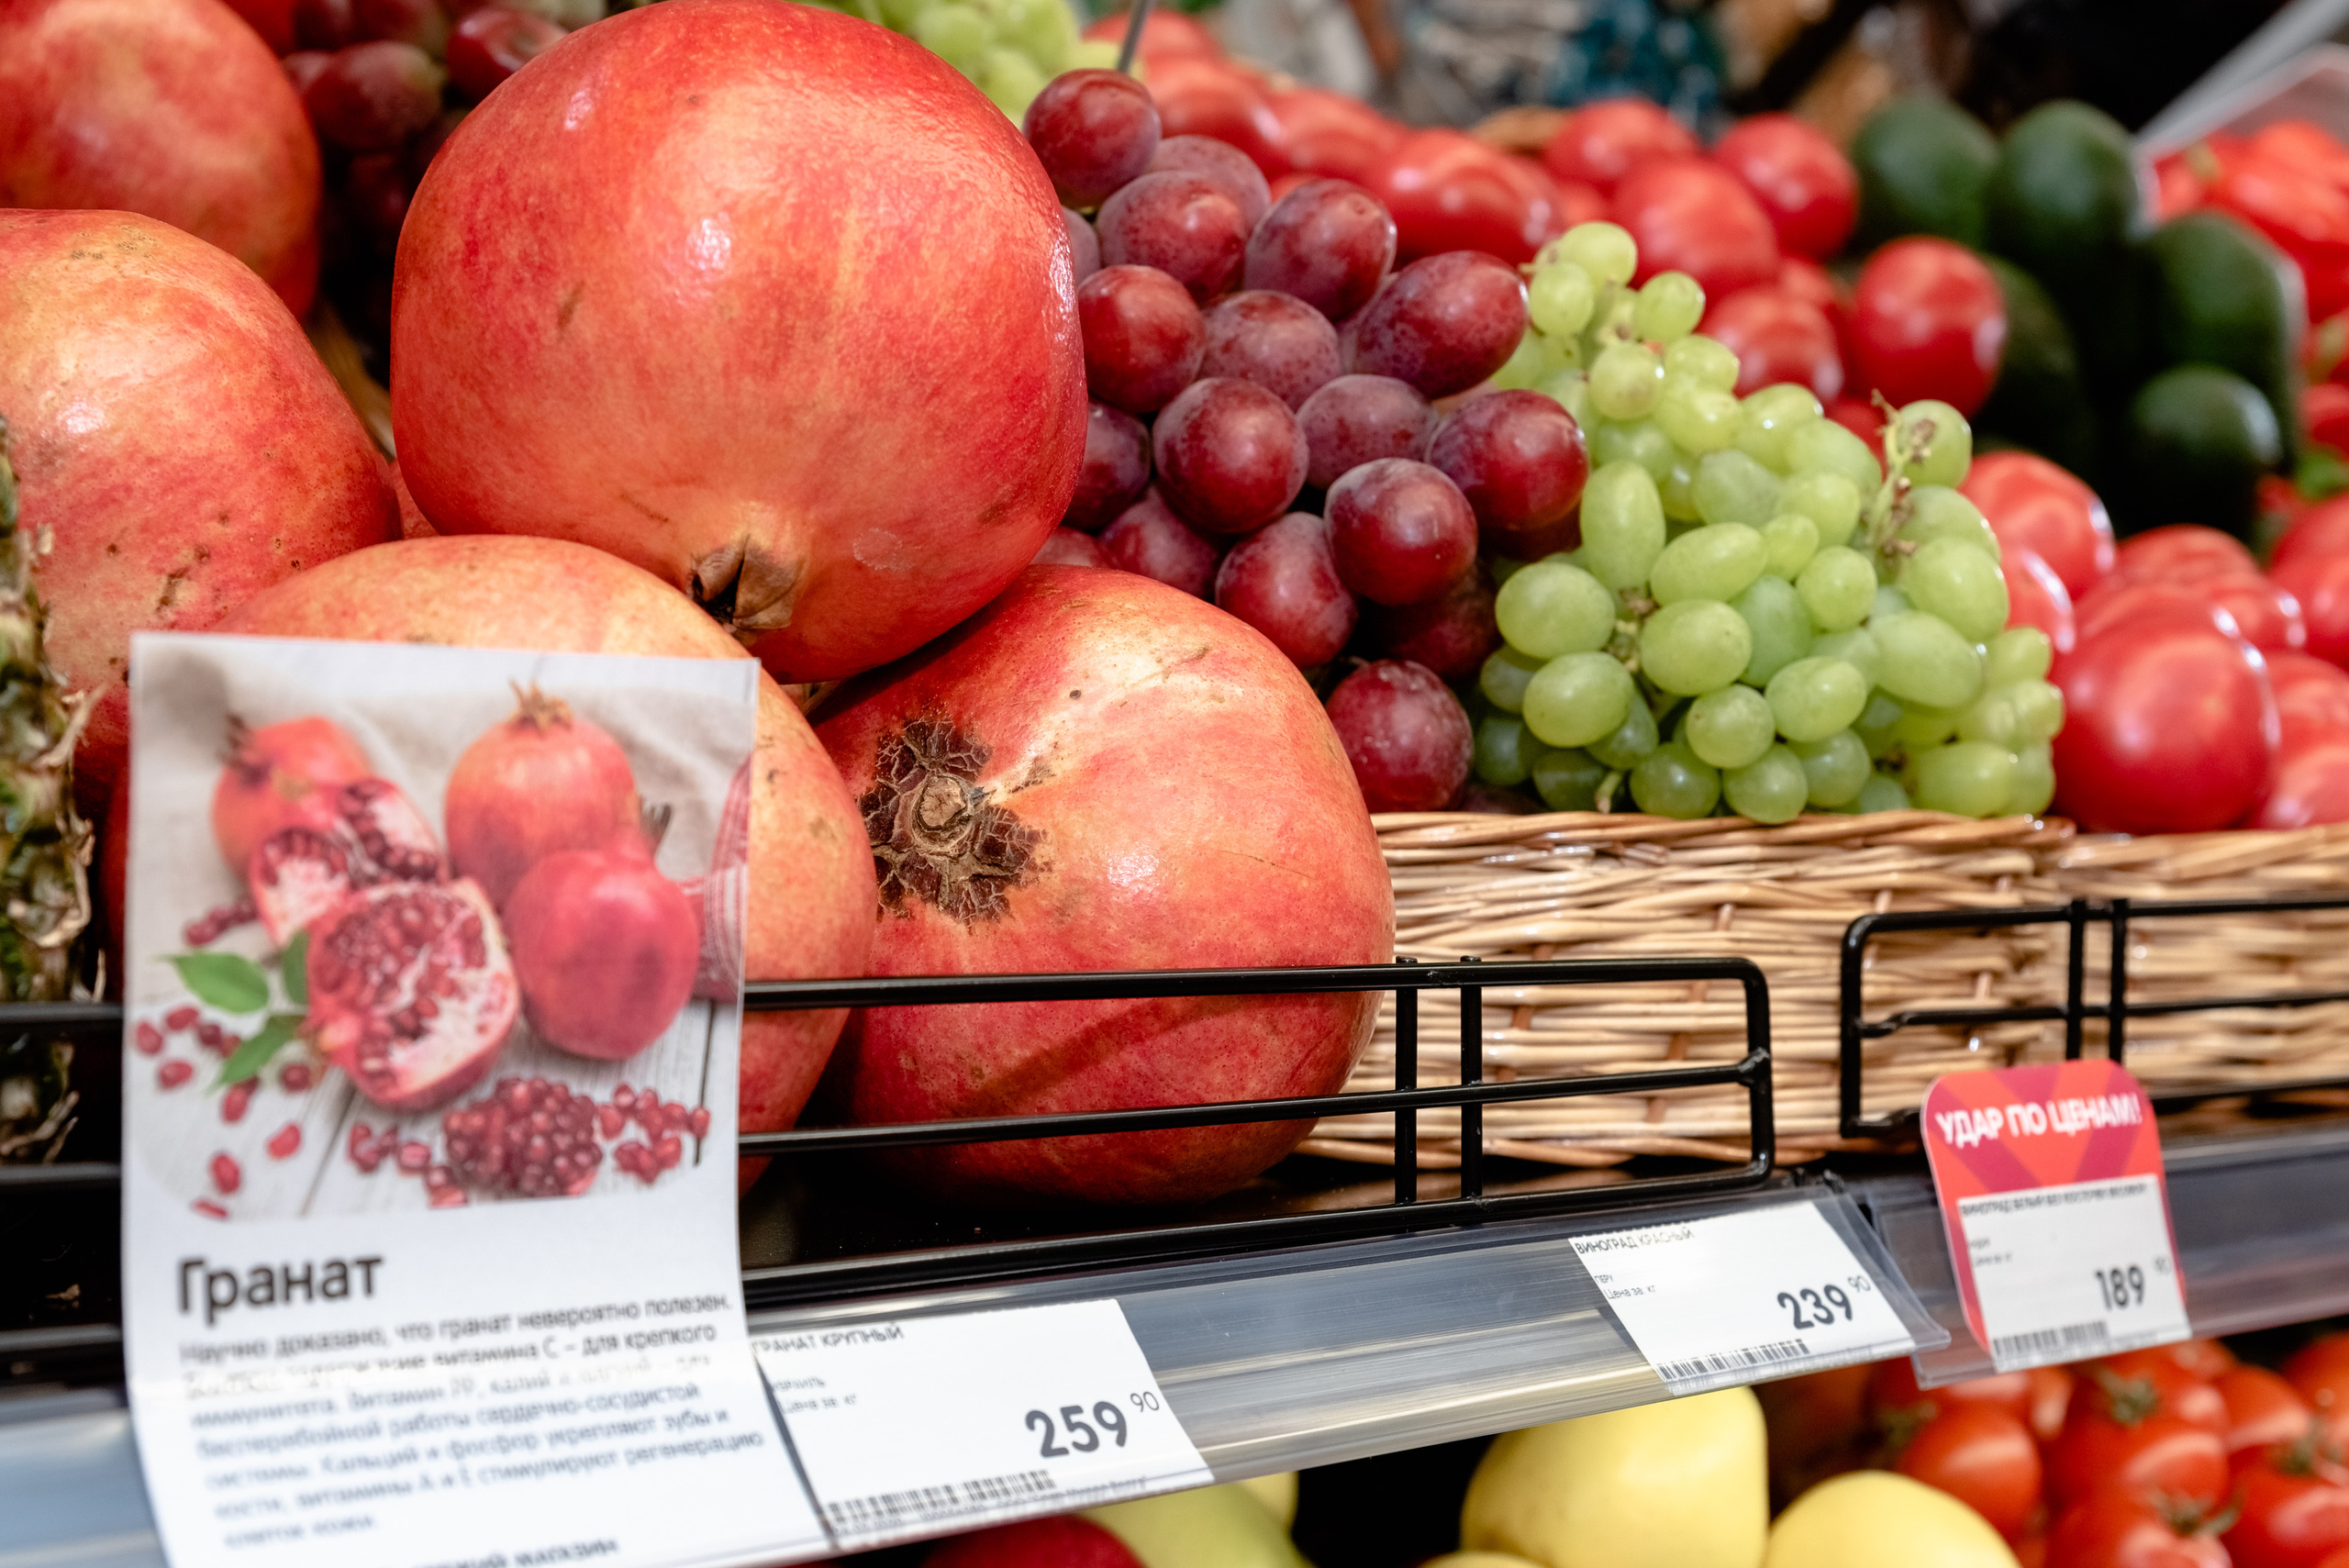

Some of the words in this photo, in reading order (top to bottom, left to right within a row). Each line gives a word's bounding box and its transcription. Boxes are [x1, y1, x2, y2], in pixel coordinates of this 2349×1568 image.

[1935, 1107, 2004, 1147] УДАР
[2006, 1102, 2047, 1137] ПО
[2047, 1093, 2142, 1136] ЦЕНАМ!
[1575, 1236, 1638, 1255] ВИНОГРАД
[1639, 1226, 1694, 1247] КРАСНЫЙ
[177, 1255, 384, 1329] Гранат
[1594, 1274, 1614, 1284] ПЕРУ
[1604, 1285, 1631, 1300] Цена
[1632, 1286, 1643, 1297] за
[1646, 1284, 1656, 1295] кг
[1848, 1275, 1871, 1293] 90
[2095, 1264, 2146, 1311] 189
[517, 1300, 641, 1332] невероятно
[645, 1294, 732, 1318] полезен.
[1776, 1284, 1853, 1330] 239
[582, 1332, 619, 1358] для
[624, 1323, 718, 1352] крепкого
[749, 1335, 817, 1355] ГРАНАТ
[819, 1321, 905, 1348] КРУПНЫЙ
[1130, 1390, 1161, 1413] 90
[1026, 1401, 1128, 1459] 259
